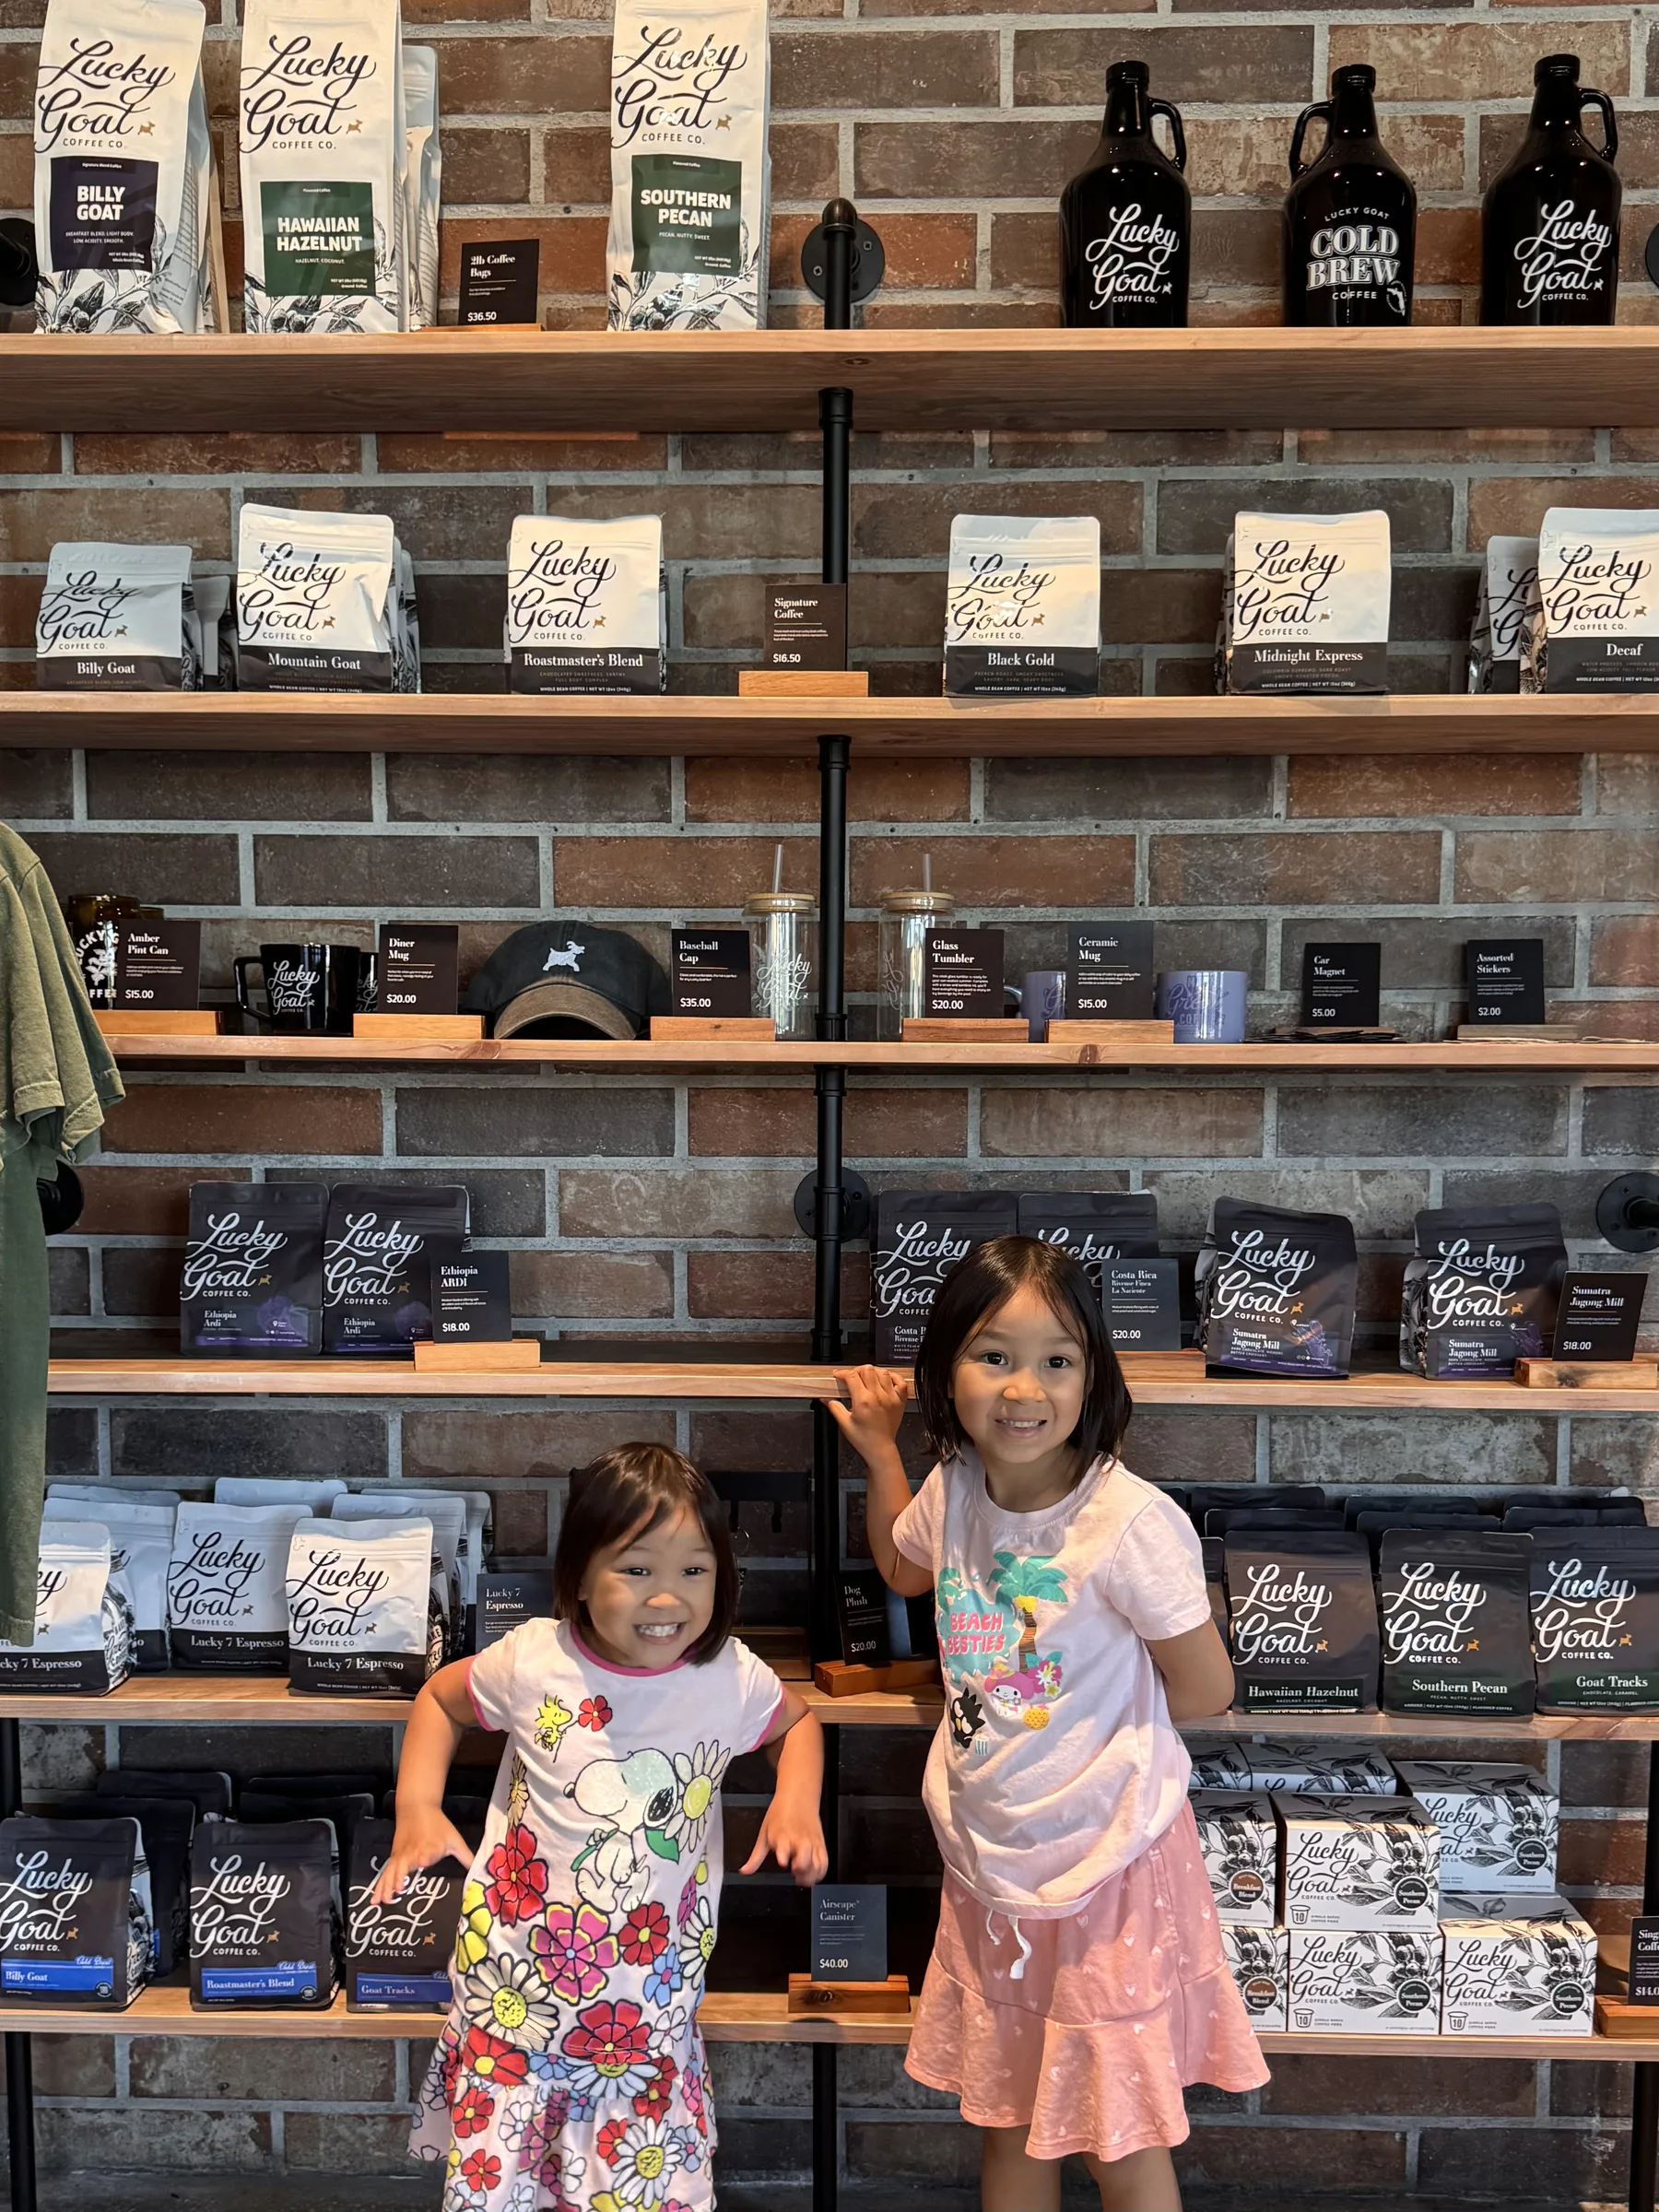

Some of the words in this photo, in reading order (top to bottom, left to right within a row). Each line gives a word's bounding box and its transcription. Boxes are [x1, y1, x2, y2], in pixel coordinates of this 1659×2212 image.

[611, 26, 747, 92] Lucky
[36, 37, 175, 102] Lucky
[241, 34, 376, 100] Lucky
[610, 78, 728, 148] Goat
[34, 88, 151, 153] Goat
[239, 88, 358, 153] Goat
[63, 138, 103, 147] COFFEE
[109, 140, 126, 148] CO.
[272, 141, 313, 149] COFFEE
[318, 141, 336, 149] CO.
[641, 133, 682, 142] COFFEE
[688, 135, 705, 145] CO.
[77, 185, 125, 202] BILLY
[640, 189, 731, 210] SOUTHERN
[76, 205, 124, 220] GOAT
[658, 208, 712, 228] PECAN
[1324, 207, 1359, 222] LUCKY
[1363, 207, 1390, 219] GOAT
[277, 217, 359, 233] HAWAIIAN
[1513, 199, 1612, 262] Lucky
[1085, 203, 1180, 265] Lucky
[276, 236, 362, 252] HAZELNUT
[1311, 225, 1399, 259] COLD
[470, 255, 485, 265] 2lb
[487, 254, 515, 265] Coffee
[470, 268, 491, 279] Bags
[1306, 255, 1401, 290] BREW
[1089, 253, 1171, 310] Goat
[1517, 252, 1602, 309] Goat
[1332, 291, 1377, 300] COFFEE
[467, 312, 497, 322] $36.50
[508, 539, 617, 598] Lucky
[1231, 539, 1345, 592] Lucky
[1539, 544, 1651, 593] Lucky
[774, 597, 818, 609] Signature
[508, 588, 601, 643] Goat
[774, 609, 804, 618] Coffee
[1231, 586, 1329, 642] Goat
[1546, 588, 1640, 635] Goat
[1606, 643, 1644, 656] Decaf
[268, 653, 328, 668] Mountain
[331, 656, 360, 670] Goat
[524, 653, 605, 667] Roastmaster's
[608, 653, 643, 667] Blend
[772, 653, 801, 663] $16.50
[987, 653, 1022, 665] Black
[1025, 653, 1054, 665] Gold
[1253, 649, 1311, 665] Midnight
[1315, 649, 1363, 664] Express
[76, 662, 104, 677] Billy
[107, 662, 135, 674] Goat
[127, 933, 160, 943] Amber
[389, 938, 415, 947] Diner
[1078, 936, 1119, 947] Ceramic
[127, 945, 149, 955] Pint
[149, 946, 170, 955] Can
[679, 940, 719, 951] Baseball
[933, 940, 959, 951] Glass
[388, 949, 409, 961] Mug
[679, 952, 699, 964] Cap
[933, 953, 975, 964] Tumbler
[1078, 949, 1101, 962] Mug
[1314, 955, 1330, 965] Car
[1477, 953, 1513, 962] Assorted
[1313, 967, 1346, 978] Magnet
[1477, 964, 1511, 974] Stickers
[267, 960, 321, 993] Lucky
[125, 989, 154, 999] $15.00
[387, 994, 417, 1004] $20.00
[271, 986, 312, 1015] Goat
[680, 997, 712, 1008] $35.00
[932, 1000, 964, 1010] $20.00
[1078, 999, 1108, 1009] $15.00
[1312, 1008, 1335, 1018] $5.00
[1478, 1006, 1500, 1017] $2.00
[184, 1213, 288, 1263] Lucky
[1218, 1230, 1316, 1287] Lucky
[180, 1253, 269, 1300] Goat
[441, 1266, 478, 1277] Ethiopia
[1112, 1270, 1135, 1279] Costa
[1137, 1270, 1158, 1279] Rica
[441, 1277, 467, 1288] ARDI
[1210, 1270, 1300, 1319] Goat
[1572, 1286, 1611, 1295] Sumatra
[1569, 1297, 1603, 1308] Jagong
[1604, 1298, 1624, 1307] Mill
[205, 1311, 237, 1320] Ethiopia
[204, 1319, 221, 1327] Ardi
[344, 1318, 376, 1327] Ethiopia
[442, 1323, 470, 1333] $18.00
[343, 1326, 361, 1335] Ardi
[894, 1325, 918, 1335] Costa
[1112, 1330, 1141, 1339] $20.00
[1232, 1328, 1267, 1340] Sumatra
[1231, 1337, 1261, 1349] Jagong
[1263, 1340, 1280, 1350] Mill
[1449, 1339, 1484, 1347] Sumatra
[1563, 1341, 1592, 1350] $18.00
[1448, 1348, 1478, 1359] Jagong
[1480, 1348, 1497, 1357] Mill
[286, 1548, 389, 1608] Lucky
[486, 1587, 512, 1600] Lucky
[514, 1587, 521, 1596] 7
[844, 1585, 861, 1596] Dog
[1230, 1563, 1333, 1624] Lucky
[486, 1600, 524, 1610] Espresso
[845, 1596, 868, 1607] Plush
[289, 1597, 372, 1646] Goat
[950, 1612, 1003, 1631] BEACH
[192, 1635, 223, 1649] Lucky
[225, 1636, 233, 1647] 7
[236, 1637, 284, 1650] Espresso
[947, 1633, 1006, 1655] BESTIES
[1232, 1613, 1323, 1665] Goat
[851, 1641, 877, 1653] $20.00
[31, 1657, 82, 1672] Espresso
[308, 1657, 342, 1671] Lucky
[345, 1658, 352, 1668] 7
[356, 1658, 404, 1671] Espresso
[1412, 1679, 1469, 1693] Southern
[1471, 1680, 1508, 1694] Pecan
[1576, 1676, 1605, 1688] Goat
[1607, 1676, 1648, 1688] Tracks
[1248, 1685, 1302, 1698] Hawaiian
[1307, 1686, 1359, 1698] Hazelnut
[1287, 1832, 1359, 1880] Lucky
[1287, 1865, 1347, 1900] Goat
[1398, 1889, 1425, 1898] Southern
[820, 1912, 855, 1921] Canister
[1294, 1912, 1305, 1923] 10
[819, 1959, 848, 1969] $40.00
[6, 1971, 26, 1982] Billy
[28, 1971, 48, 1982] Goat
[206, 1978, 266, 1989] Roastmaster's
[268, 1978, 295, 1987] Blend
[361, 1985, 382, 1994] Goat
[384, 1985, 415, 1994] Tracks
